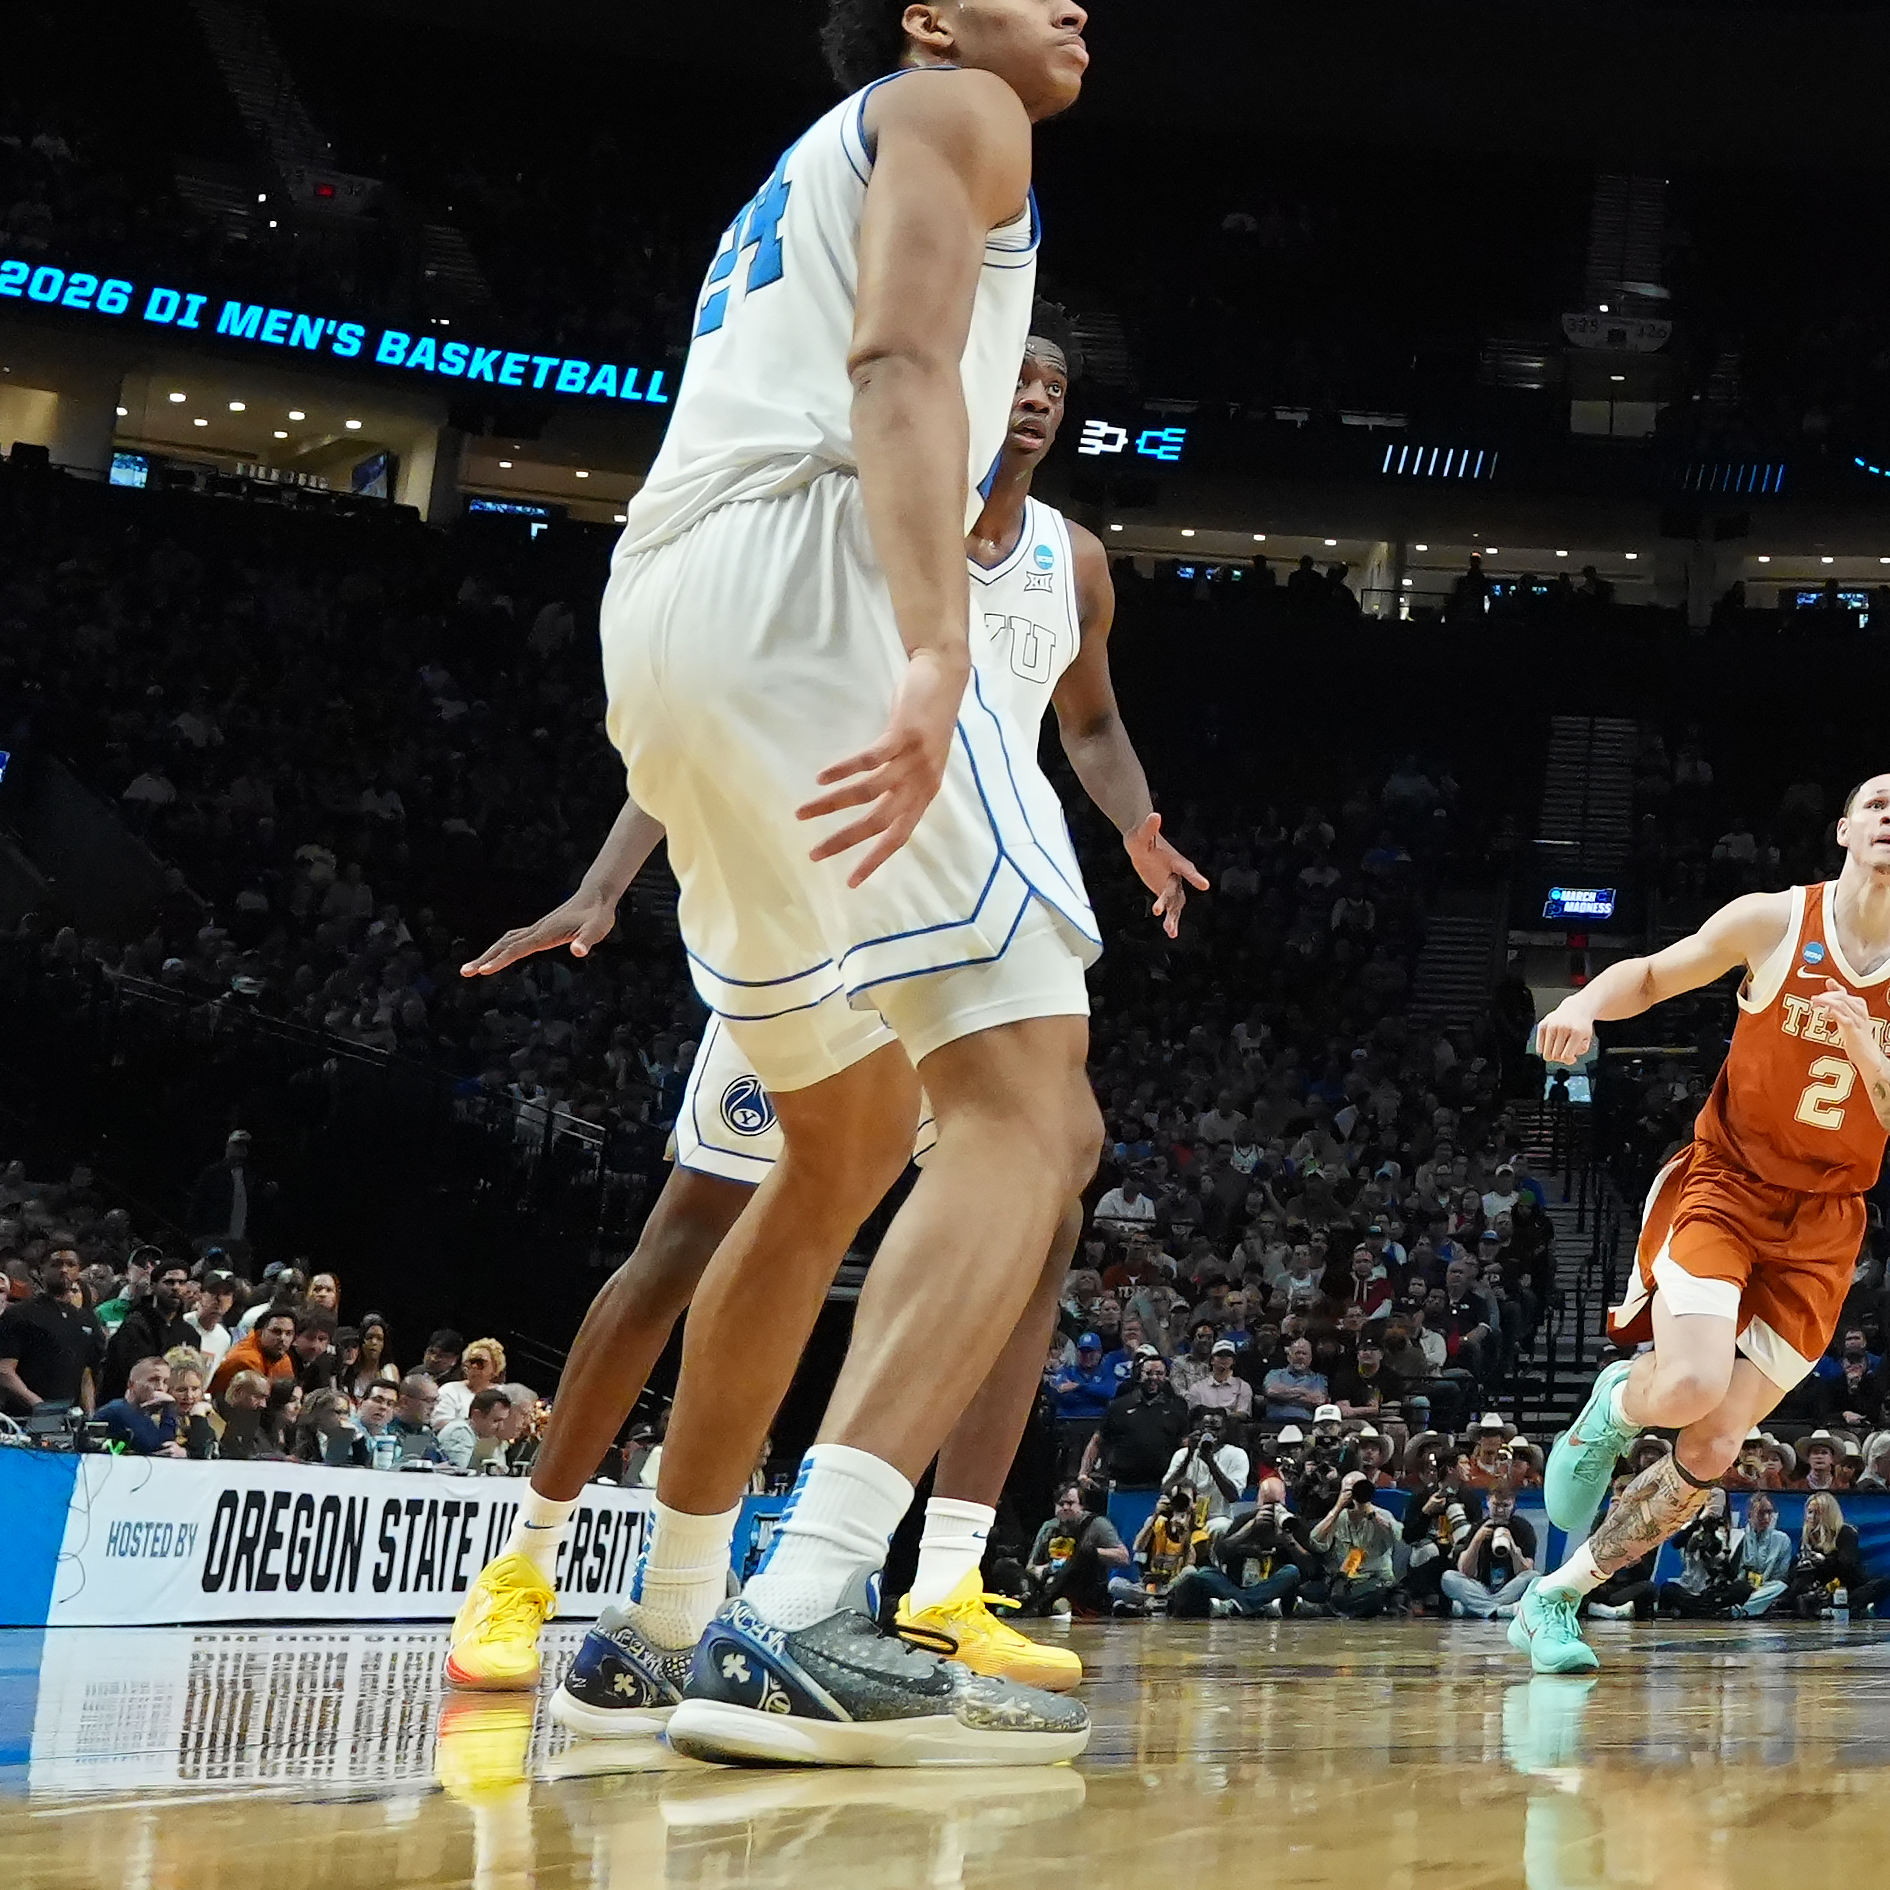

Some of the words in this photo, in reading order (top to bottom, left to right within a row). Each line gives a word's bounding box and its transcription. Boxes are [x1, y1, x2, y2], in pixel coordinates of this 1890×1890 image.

[692, 140, 792, 344] 24
[0, 260, 133, 314] 2026
[143, 287, 207, 329] DI
[216, 300, 365, 357] MEN'S
[375, 330, 667, 403] BASKETBALL
[1560, 891, 1597, 902] MARCH
[1563, 902, 1613, 914] MADNESS
[1794, 1056, 1857, 1131] 2
[106, 1520, 173, 1557] HOSTED
[173, 1523, 198, 1557] BY
[201, 1489, 368, 1592] OREGON
[372, 1498, 479, 1592] STATE
